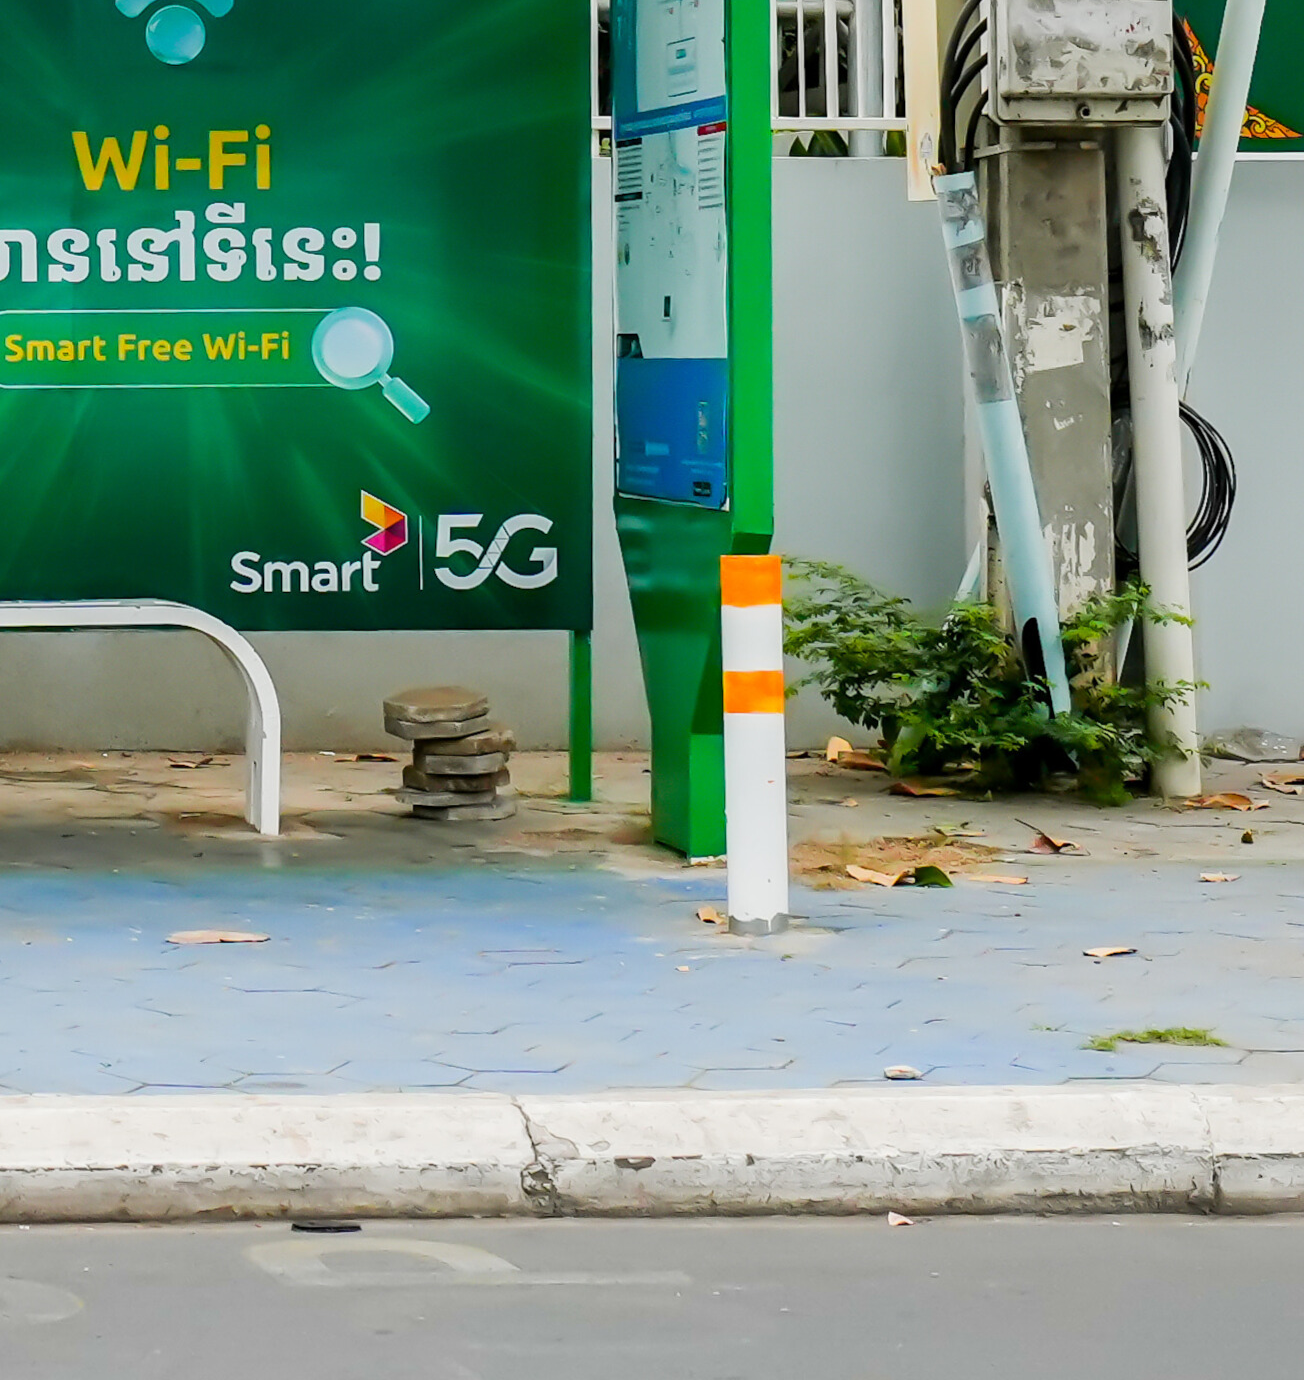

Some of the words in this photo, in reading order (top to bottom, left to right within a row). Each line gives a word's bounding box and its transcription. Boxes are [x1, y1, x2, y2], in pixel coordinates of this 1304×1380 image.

[71, 123, 272, 191] Wi-Fi
[3, 333, 106, 363] Smart
[117, 332, 193, 362] Free
[202, 331, 290, 361] Wi-Fi
[230, 549, 381, 594] Smart
[433, 513, 559, 591] 5G
